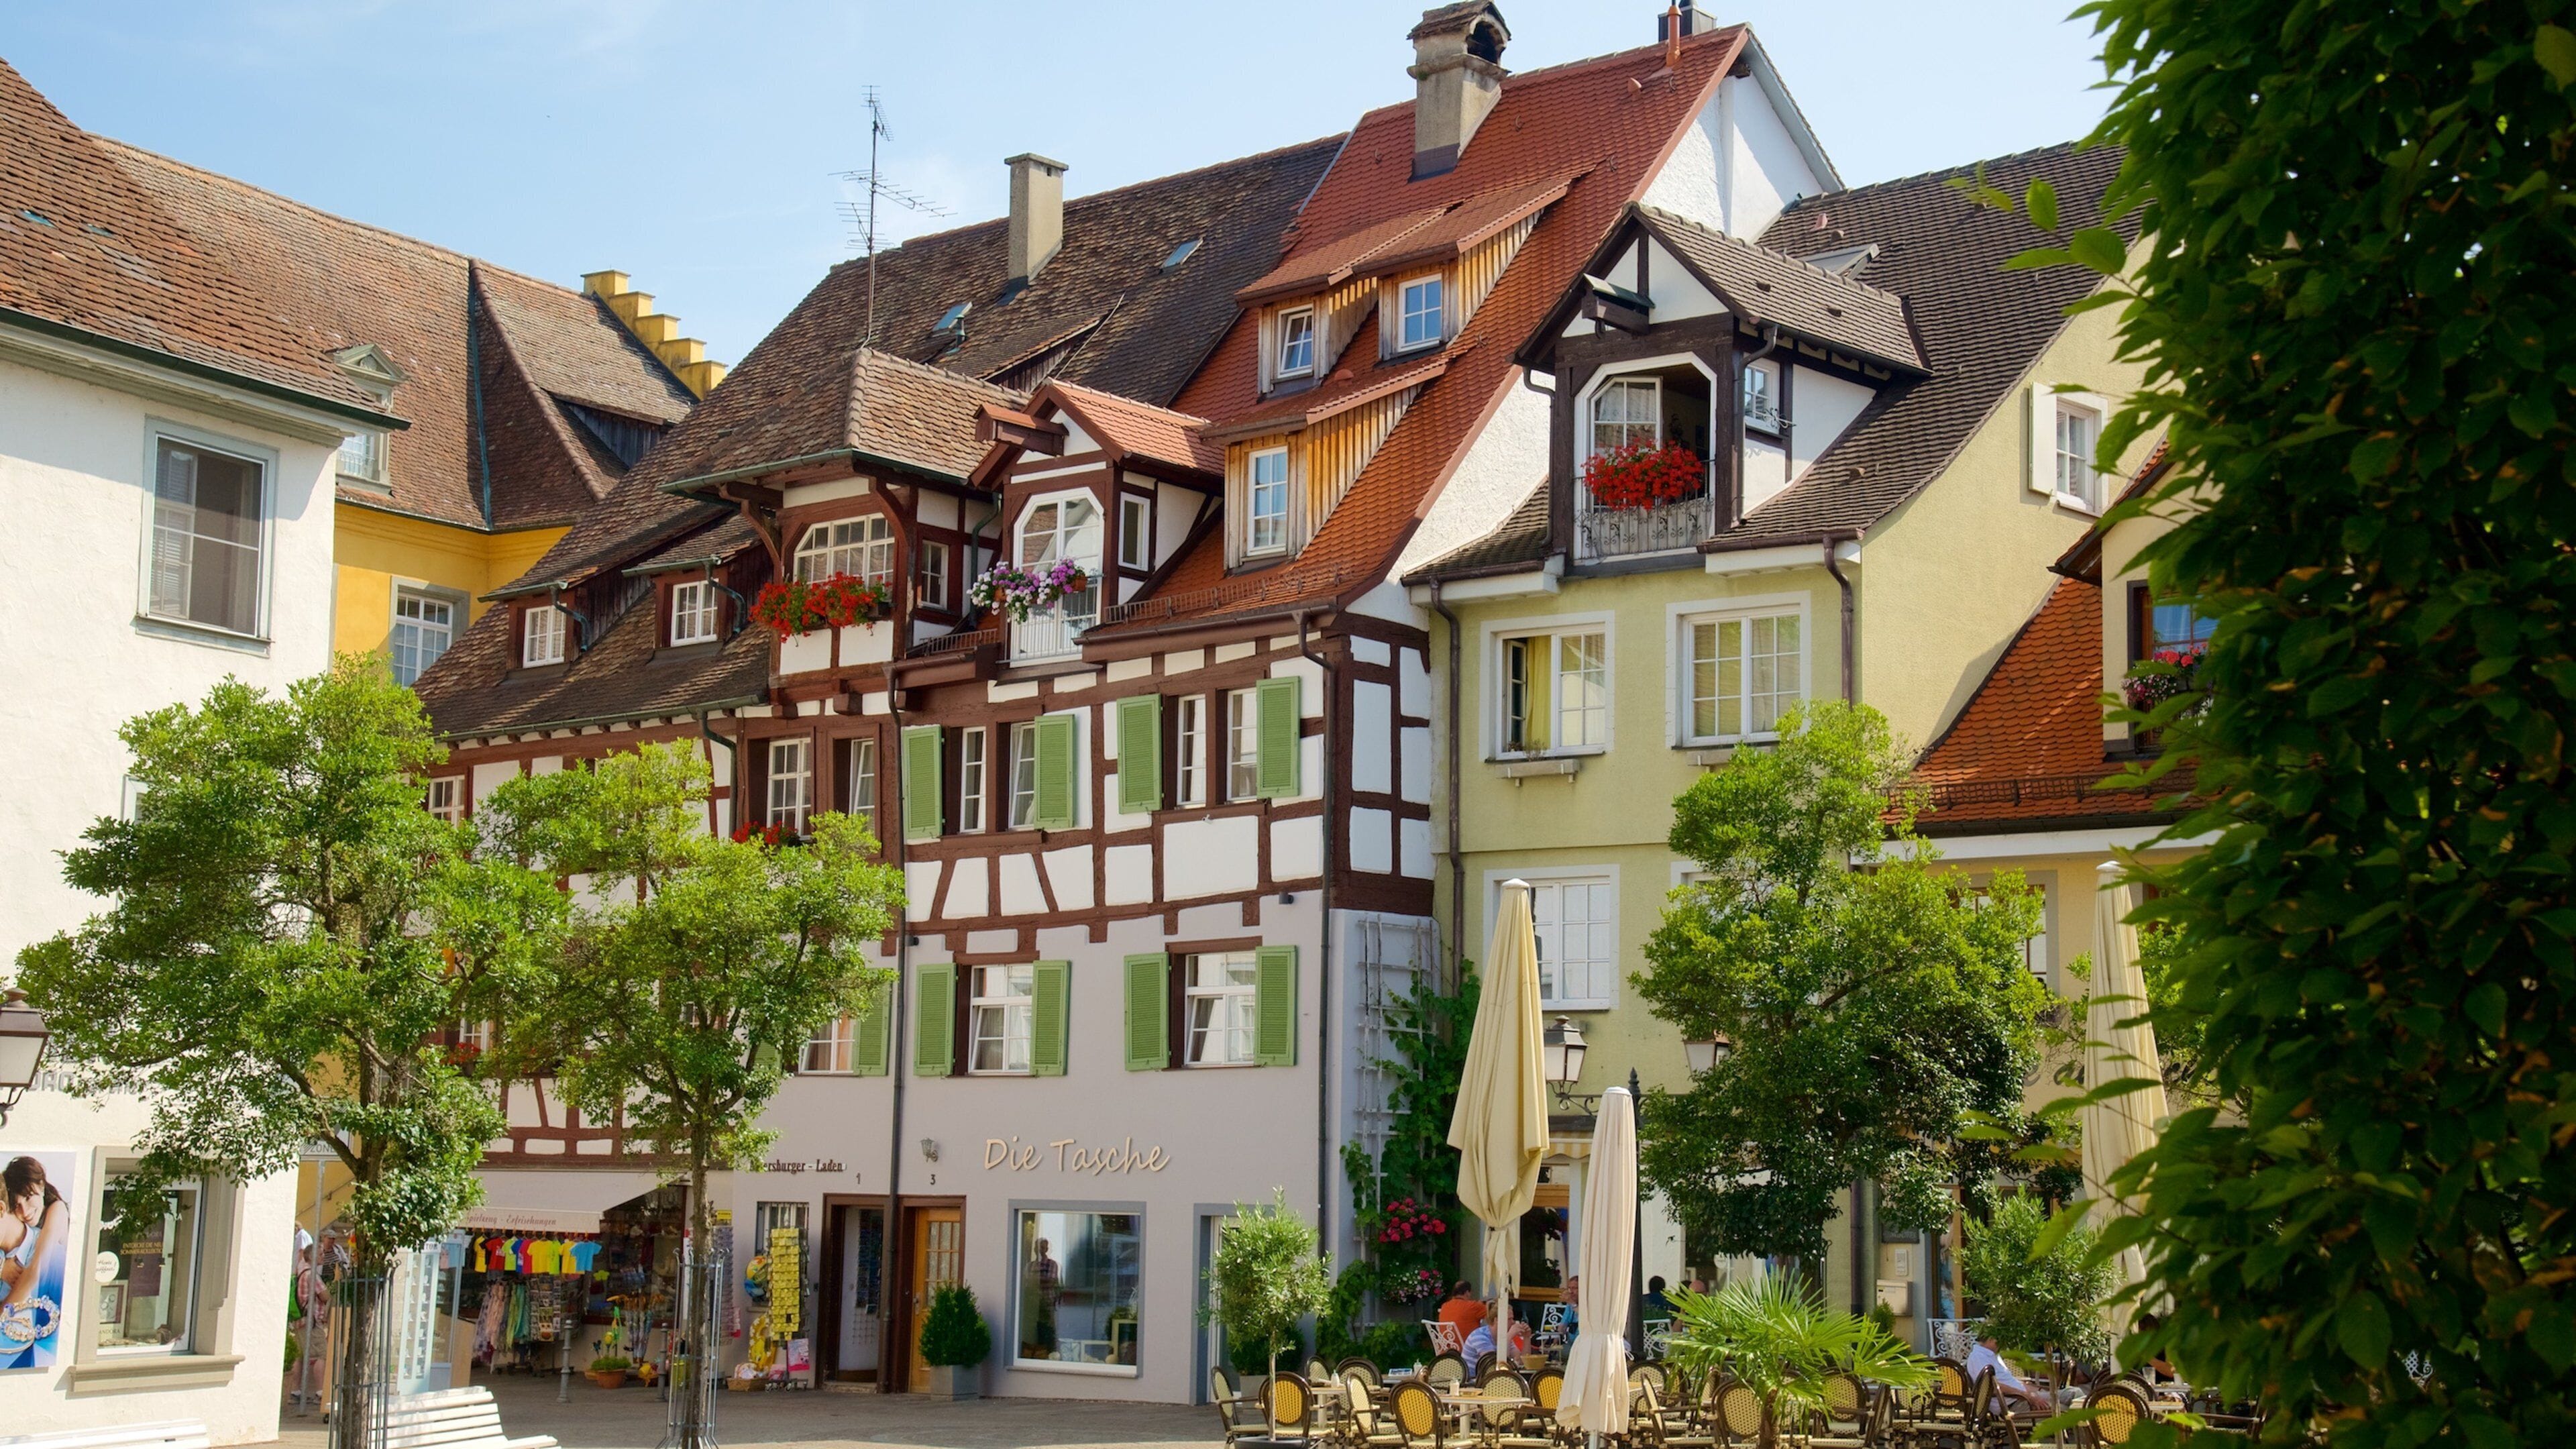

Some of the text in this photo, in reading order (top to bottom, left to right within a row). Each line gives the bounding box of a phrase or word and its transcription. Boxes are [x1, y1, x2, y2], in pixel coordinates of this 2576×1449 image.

[984, 1136, 1171, 1177] Die Tasche
[750, 1159, 805, 1174] ersburger
[816, 1159, 843, 1173] Laden
[856, 1173, 861, 1185] 1
[930, 1174, 936, 1185] 3
